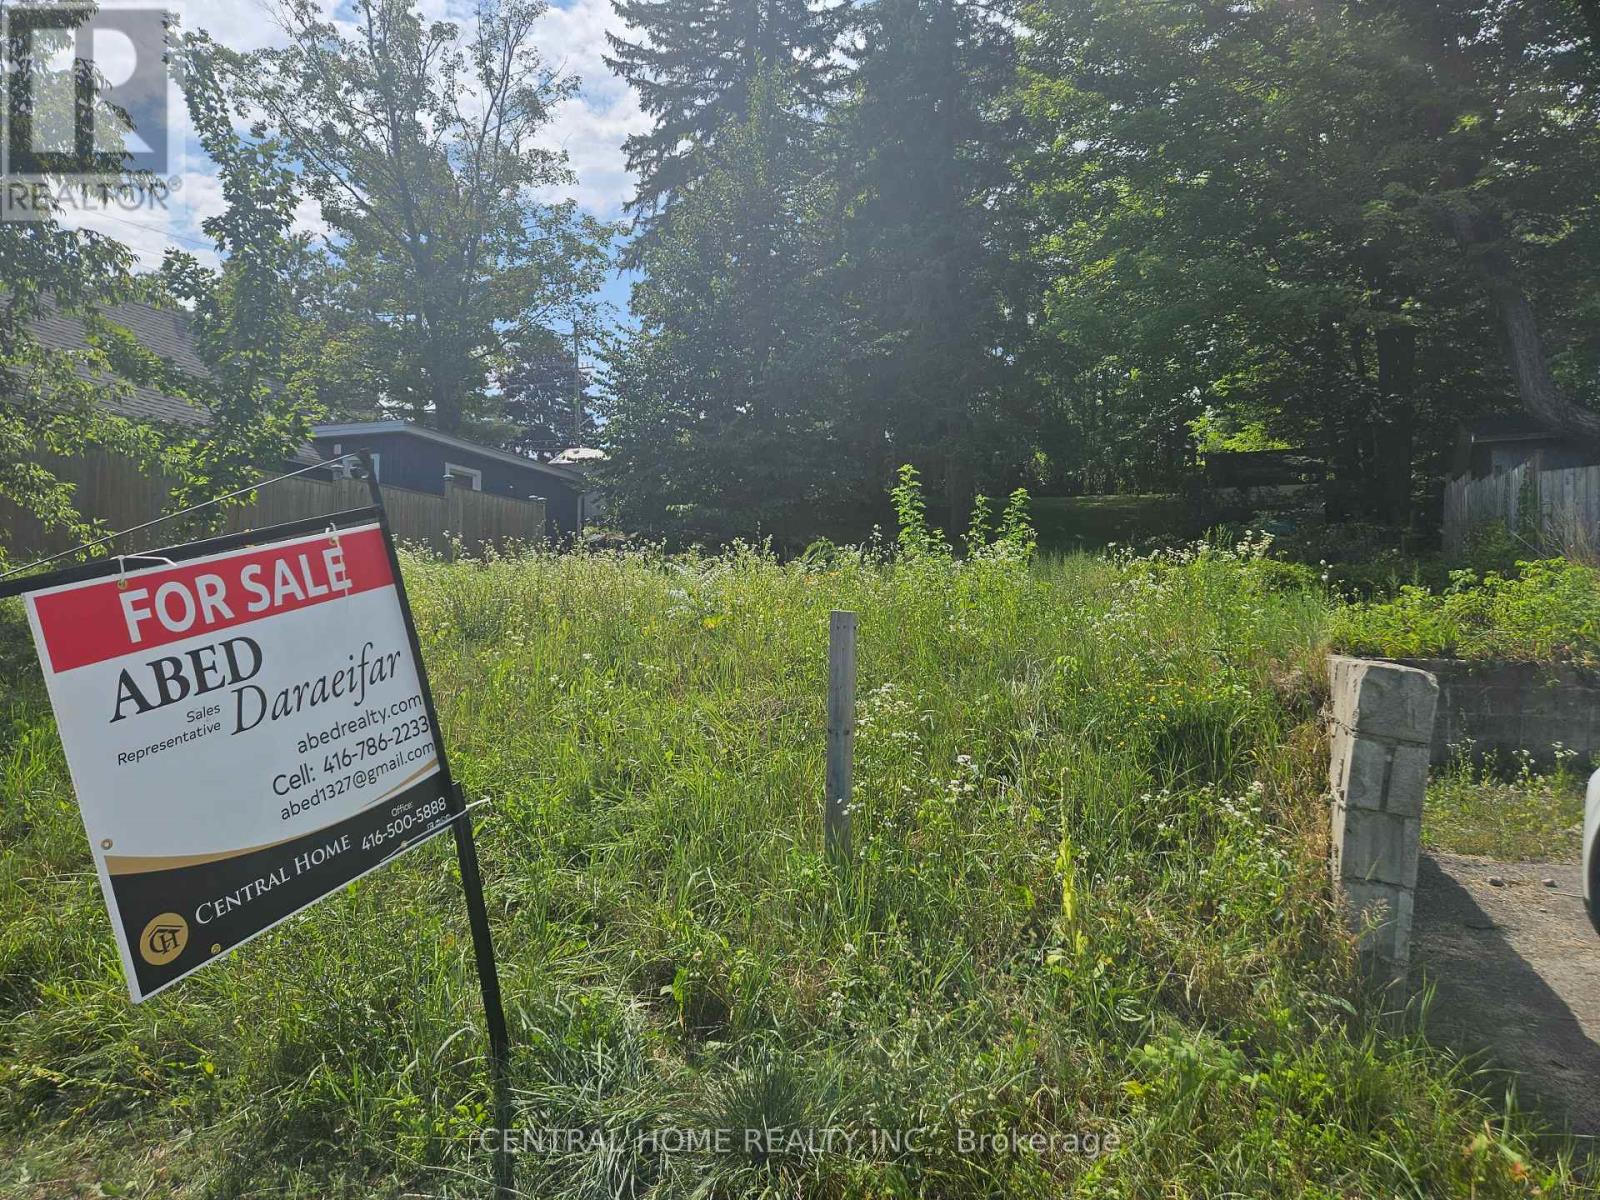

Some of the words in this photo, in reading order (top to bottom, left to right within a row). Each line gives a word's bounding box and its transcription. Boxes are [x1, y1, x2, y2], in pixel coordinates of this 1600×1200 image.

[119, 573, 235, 643] FOR
[240, 546, 352, 613] SALE
[109, 636, 263, 723] ABED
[186, 705, 221, 723] Sales
[231, 642, 401, 736] Daraeifar
[117, 721, 221, 765] Representative
[272, 762, 316, 796] Cell:
[323, 715, 430, 773] 416-786-2233
[297, 694, 422, 754] abedrealty.com
[280, 742, 434, 820] abed1327@gmail.com
[362, 796, 446, 850] 416-500-5888
[195, 867, 291, 924] CENTRAL
[294, 834, 351, 875] HOME
